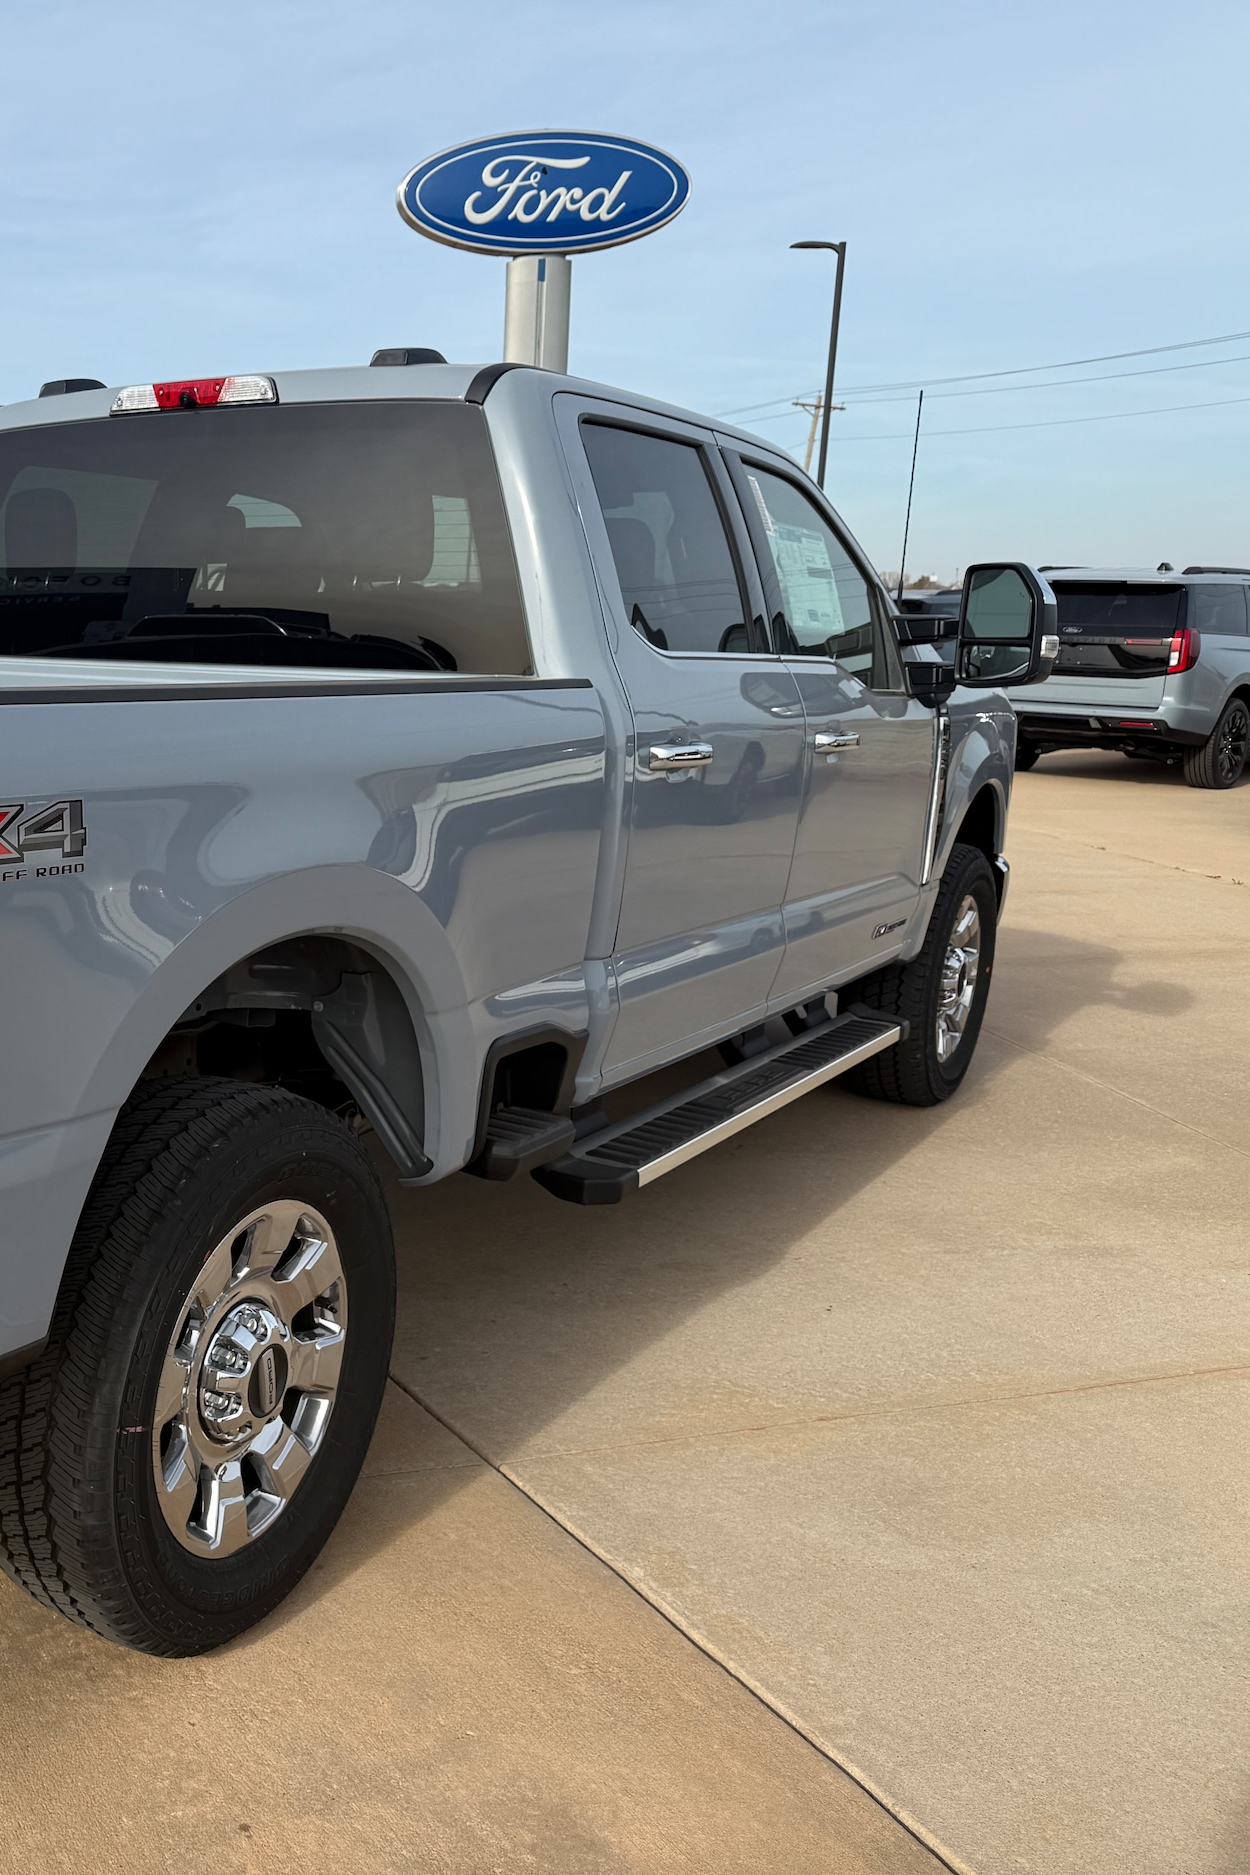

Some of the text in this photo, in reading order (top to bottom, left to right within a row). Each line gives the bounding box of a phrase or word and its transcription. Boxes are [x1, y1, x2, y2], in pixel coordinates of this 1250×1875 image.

[463, 154, 633, 225] Ford
[35, 862, 86, 879] ROAD
[266, 1357, 274, 1405] FORD
